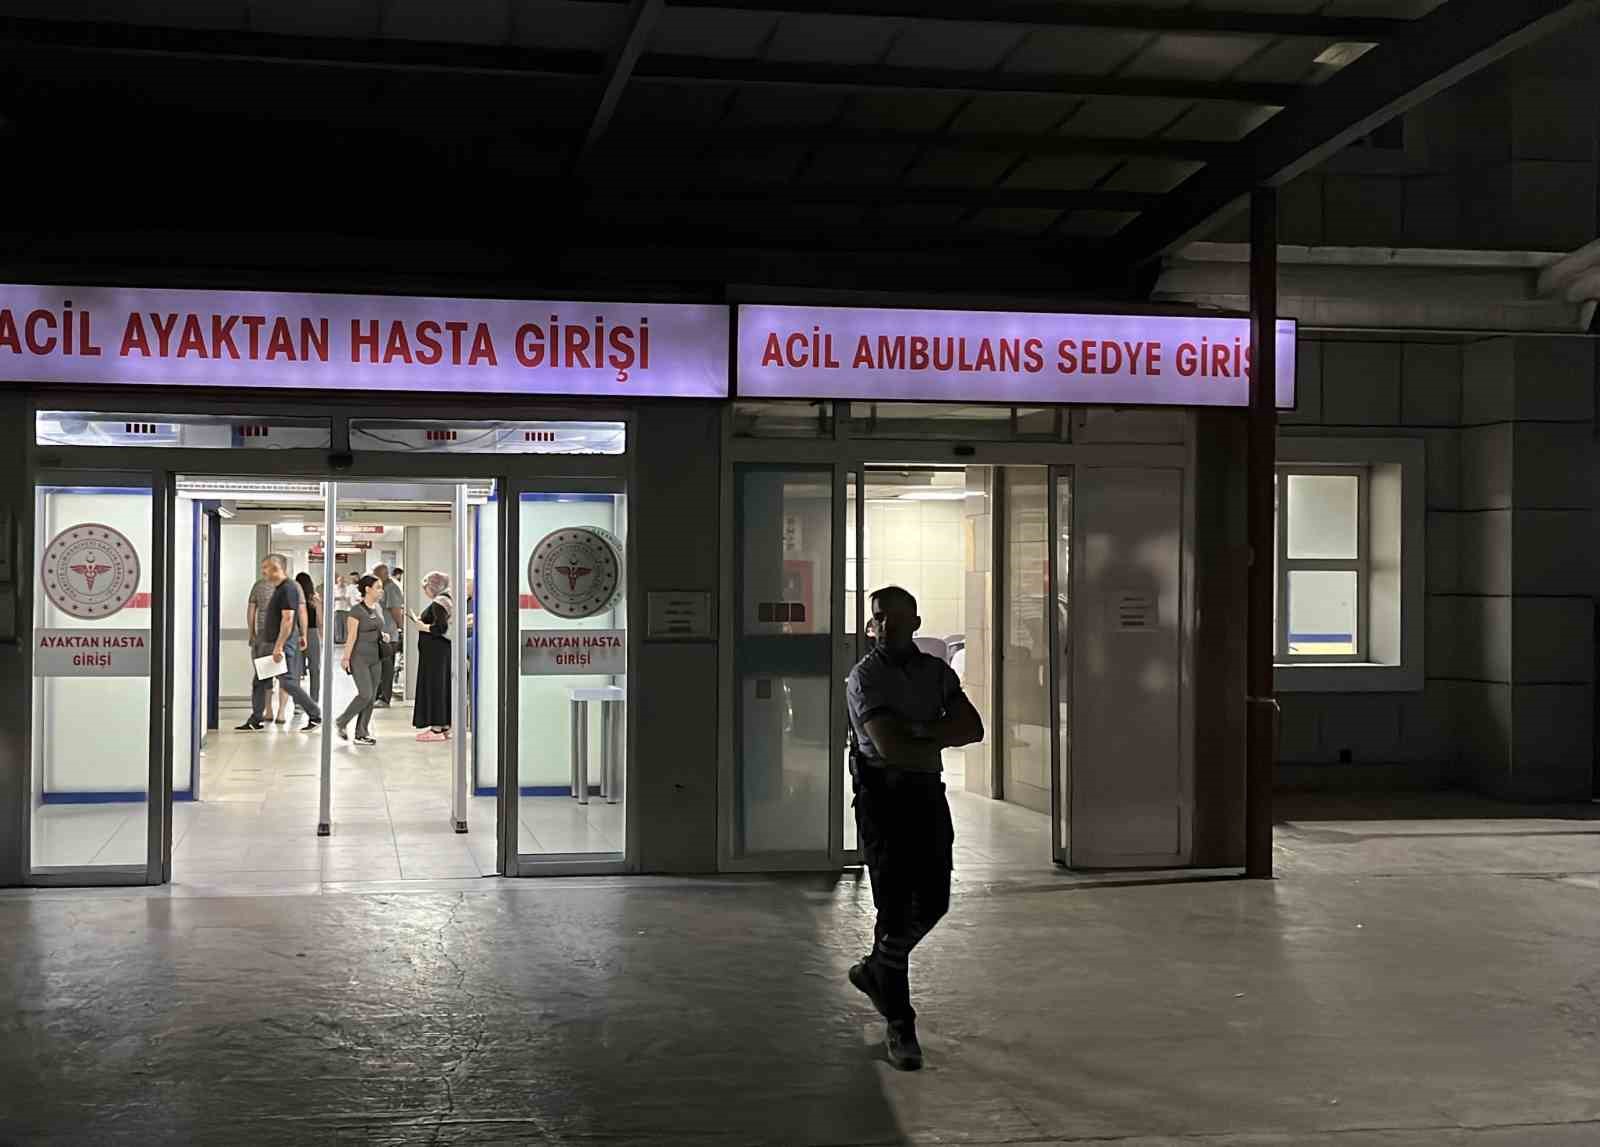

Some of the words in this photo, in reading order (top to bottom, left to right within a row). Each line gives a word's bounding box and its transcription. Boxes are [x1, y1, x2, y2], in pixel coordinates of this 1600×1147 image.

[0, 300, 102, 356] ACİL
[120, 312, 329, 362] AYAKTAN
[351, 319, 498, 366] HASTA
[515, 315, 649, 382] GİRİŞİ
[761, 326, 840, 369] ACİL
[852, 334, 1044, 373] AMBULANS
[1057, 339, 1161, 376] SEDYE
[40, 636, 99, 649] AYAKTAN
[103, 637, 145, 649] HASTA
[526, 636, 580, 648] AYAKTAN
[583, 636, 621, 648] HASTA
[72, 652, 112, 668] GİRİŞİ
[556, 651, 591, 668] GİRİŞİ
